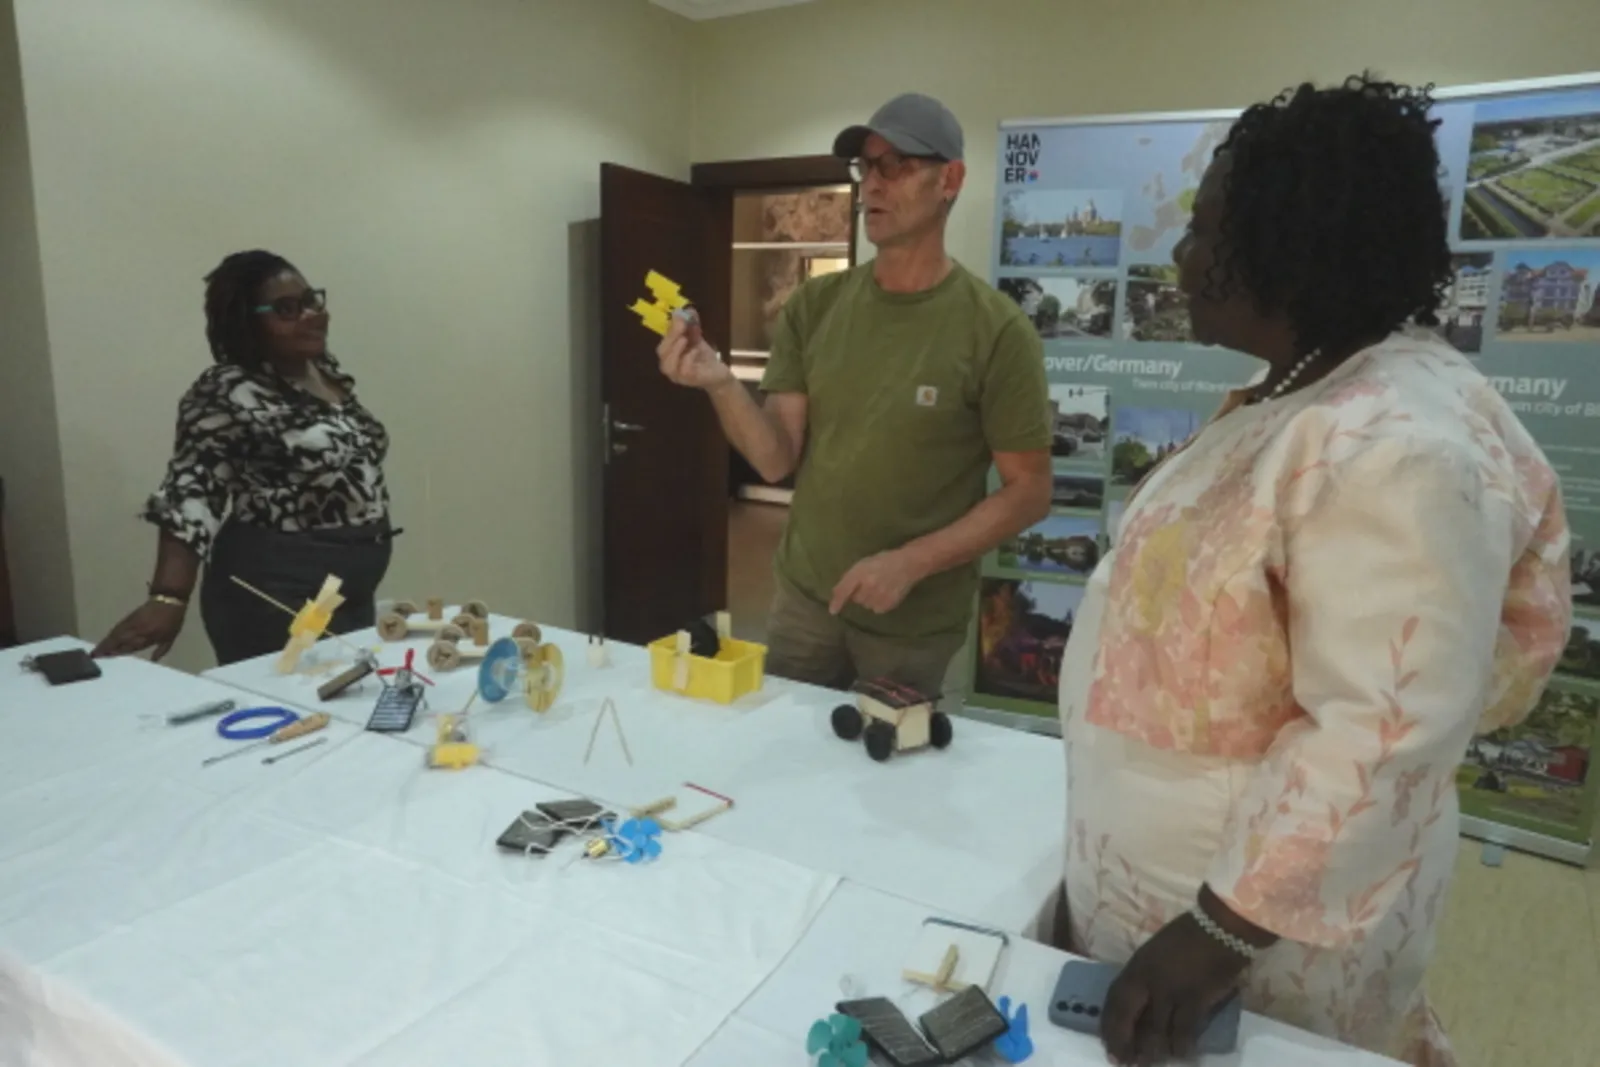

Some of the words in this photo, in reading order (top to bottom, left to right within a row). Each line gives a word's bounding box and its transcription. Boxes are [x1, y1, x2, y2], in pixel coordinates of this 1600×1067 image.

[1007, 132, 1041, 150] HAN
[1005, 167, 1027, 184] ER
[1564, 402, 1583, 415] of
